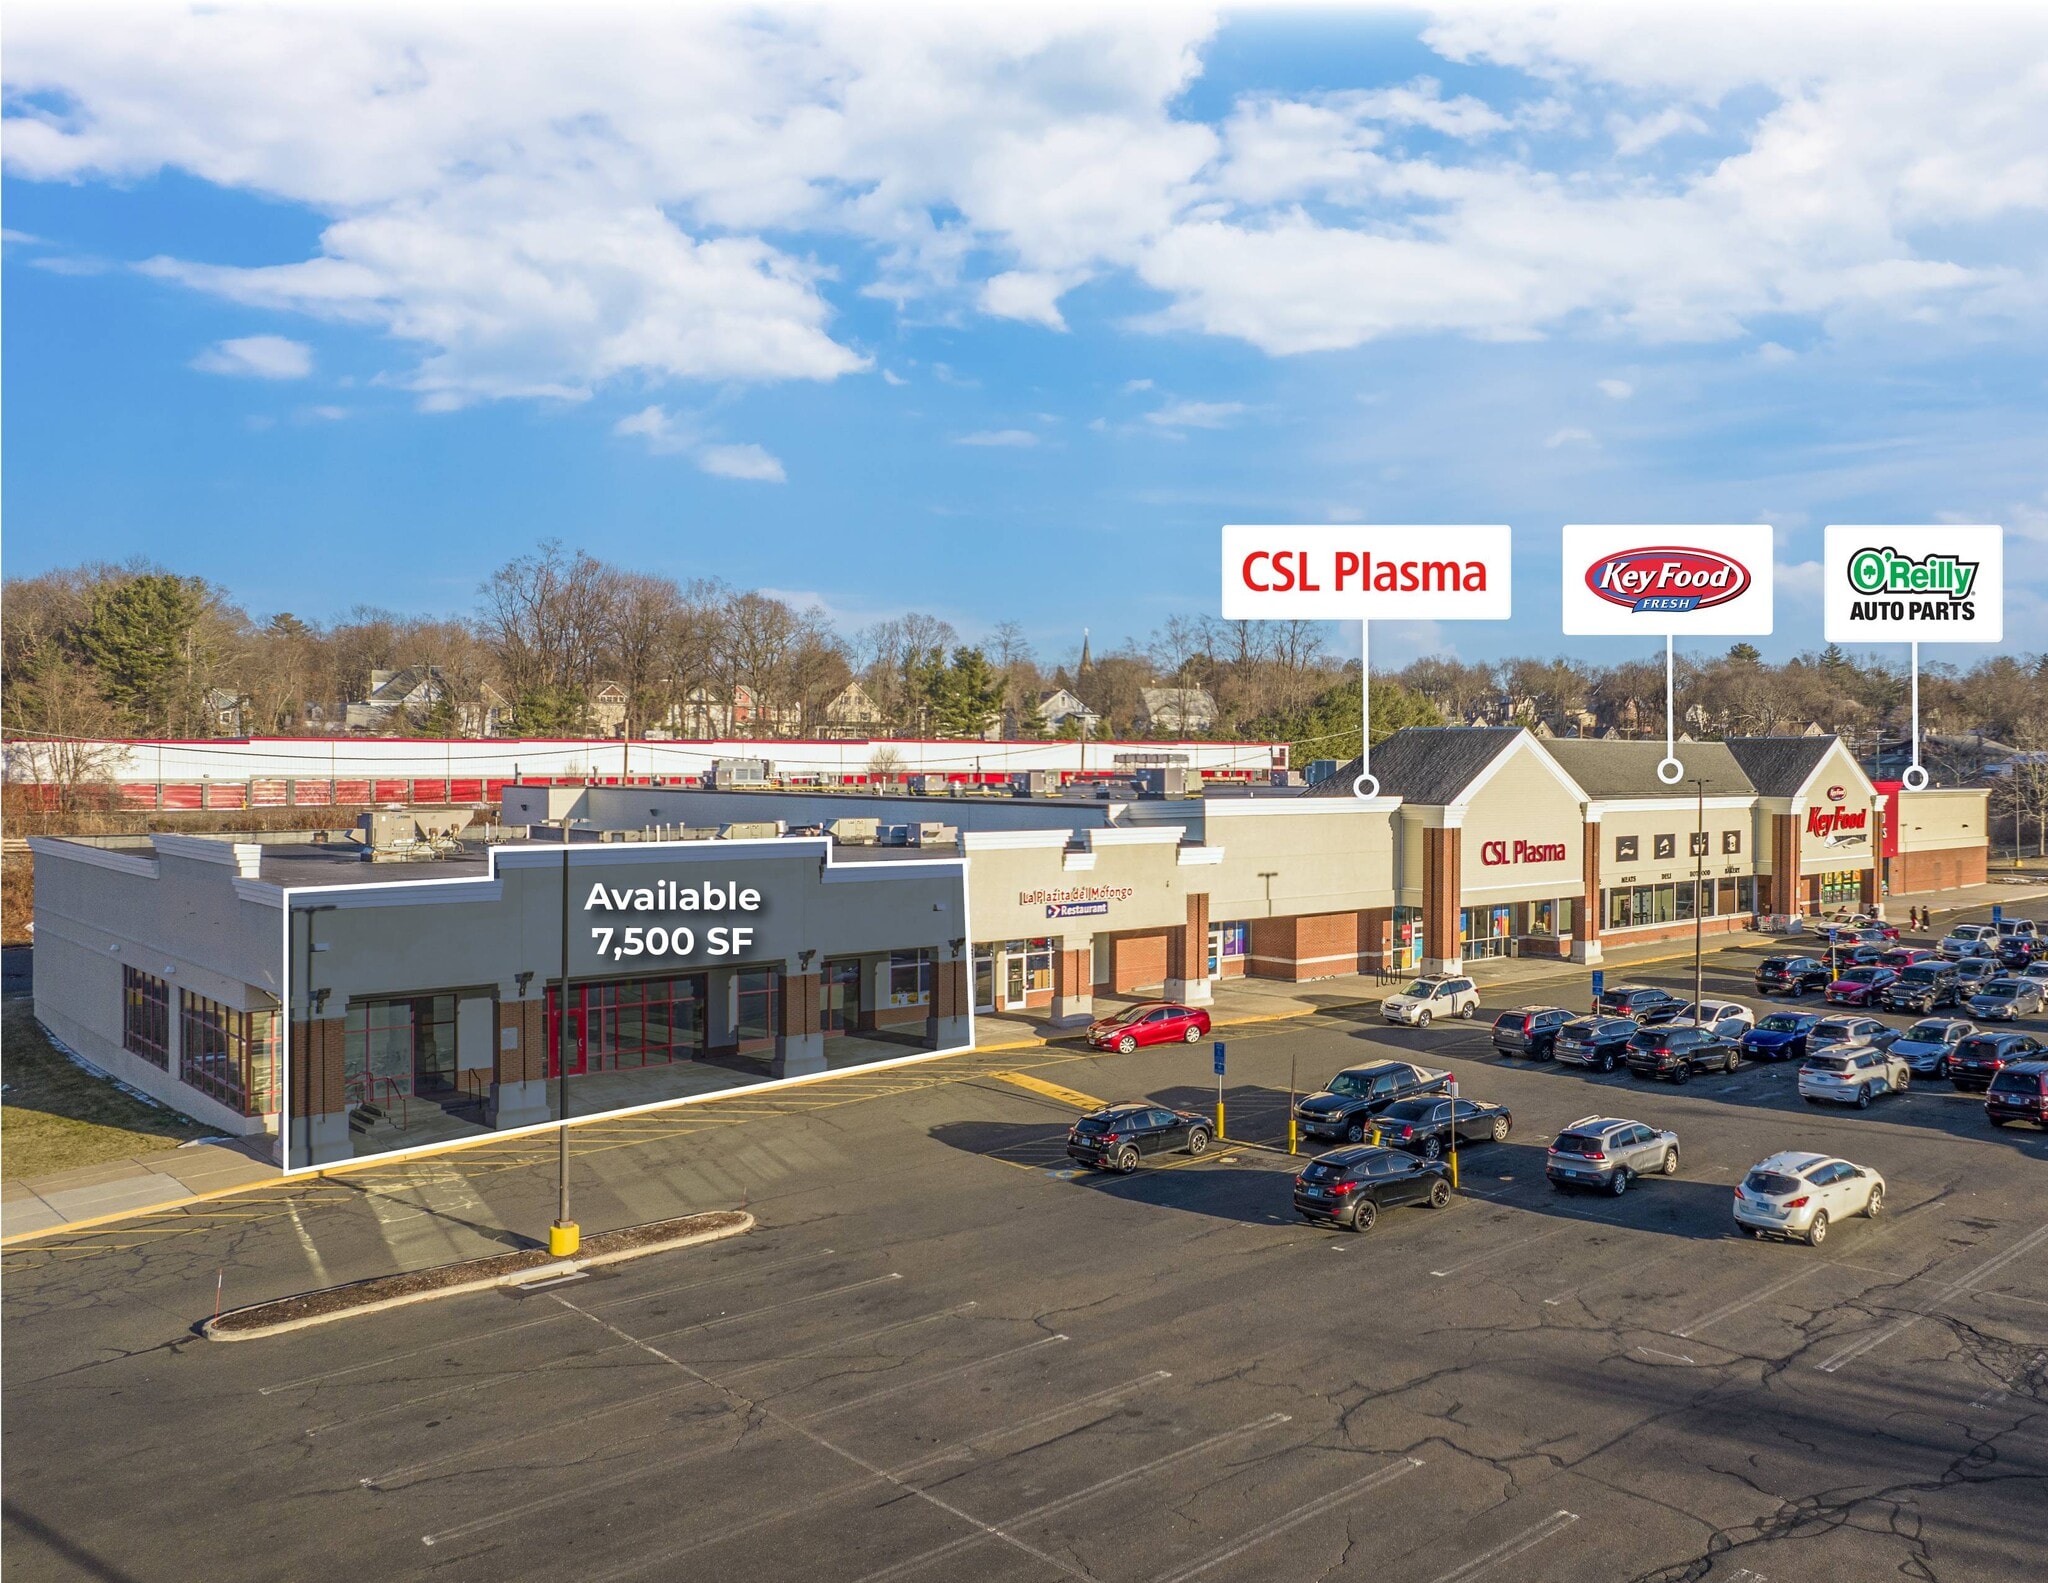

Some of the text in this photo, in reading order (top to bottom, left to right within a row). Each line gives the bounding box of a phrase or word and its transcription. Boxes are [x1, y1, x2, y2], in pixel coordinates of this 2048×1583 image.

[1481, 840, 1565, 866] CSL Plasma
[1022, 886, 1133, 904] La Plazita del Mofongo
[1060, 903, 1107, 916] Restaurant
